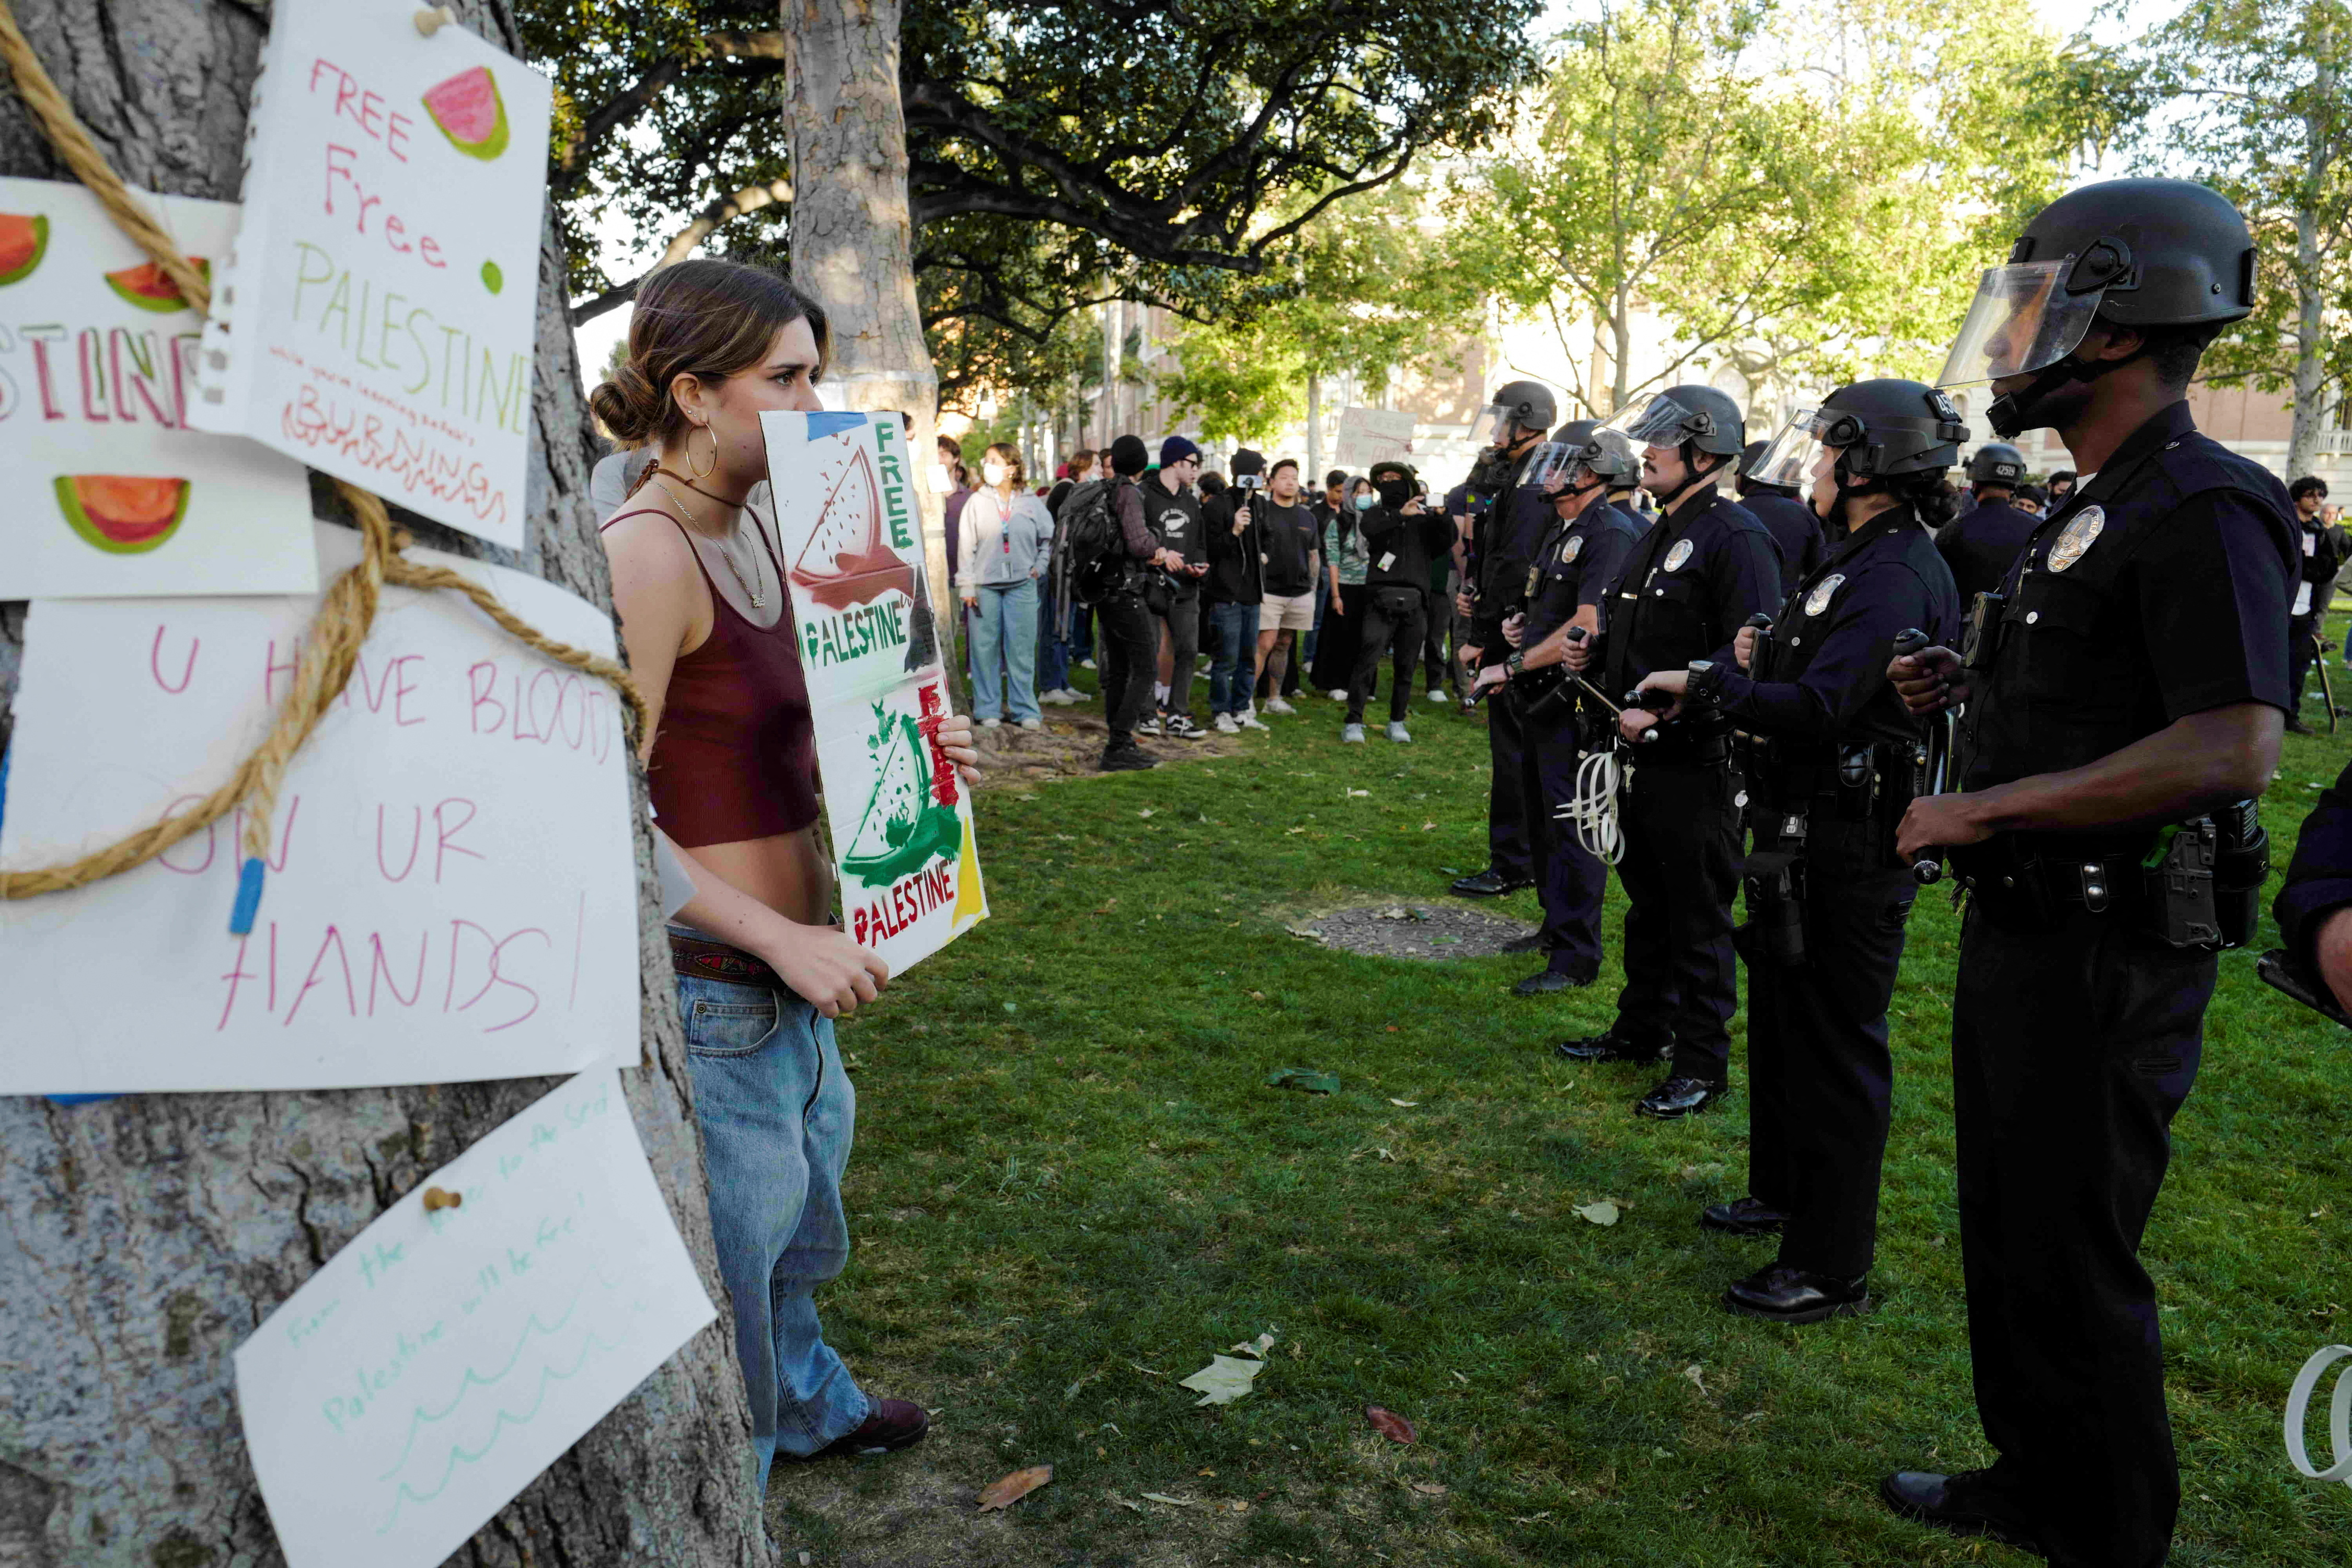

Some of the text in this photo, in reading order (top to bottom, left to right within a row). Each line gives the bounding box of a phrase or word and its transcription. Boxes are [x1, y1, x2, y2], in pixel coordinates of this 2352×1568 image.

[309, 57, 413, 163] FREE
[324, 142, 448, 269] Free
[293, 240, 532, 436] PALESTINE
[295, 383, 491, 502] BURNING
[875, 422, 914, 549] FREE
[805, 599, 907, 670] PALESTINE
[151, 625, 612, 765] U HVE BLOOD
[377, 797, 488, 884] UR
[854, 858, 955, 949] PALESTINE
[358, 1241, 406, 1290] the
